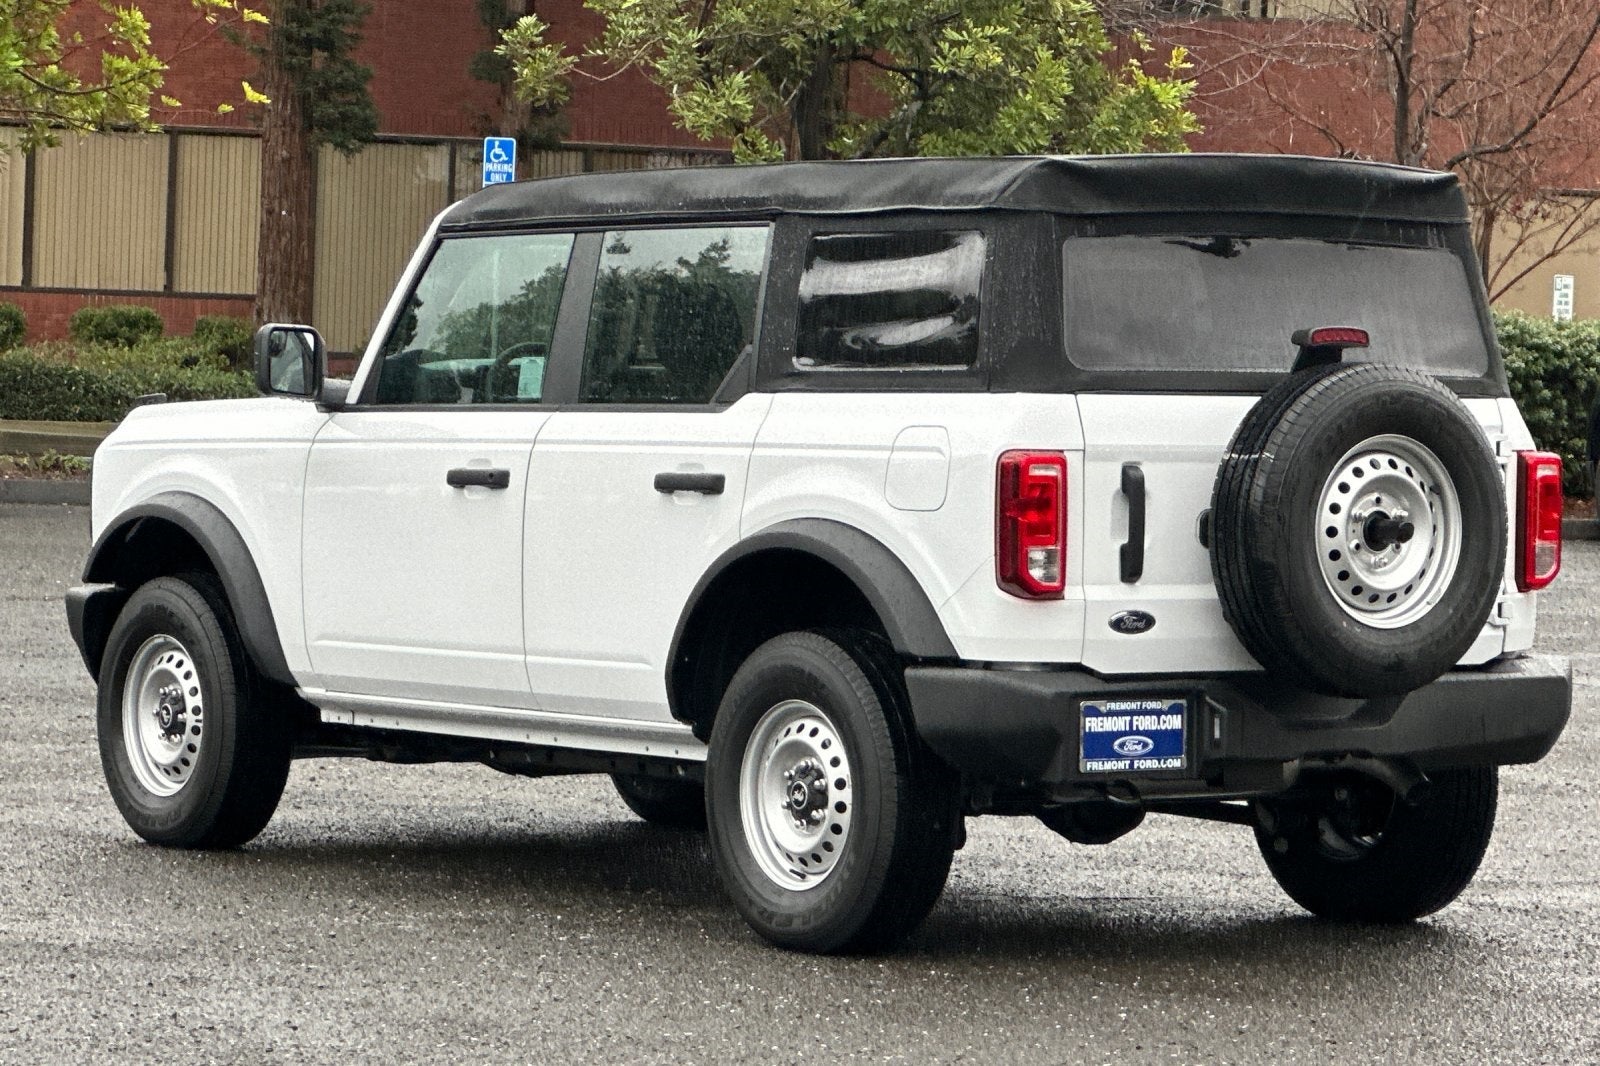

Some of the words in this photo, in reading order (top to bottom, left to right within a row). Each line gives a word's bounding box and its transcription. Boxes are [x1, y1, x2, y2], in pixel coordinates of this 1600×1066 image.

[486, 162, 513, 172] PARKING
[490, 172, 507, 182] ONLY
[1106, 702, 1141, 711] FREMONT
[1142, 701, 1162, 710] FORD
[1085, 716, 1131, 732] FREMONT
[1133, 715, 1182, 731] FORD.COM
[1123, 740, 1144, 751] Ford
[1086, 760, 1131, 771] FREMONT
[1133, 759, 1181, 770] FORD.COM
